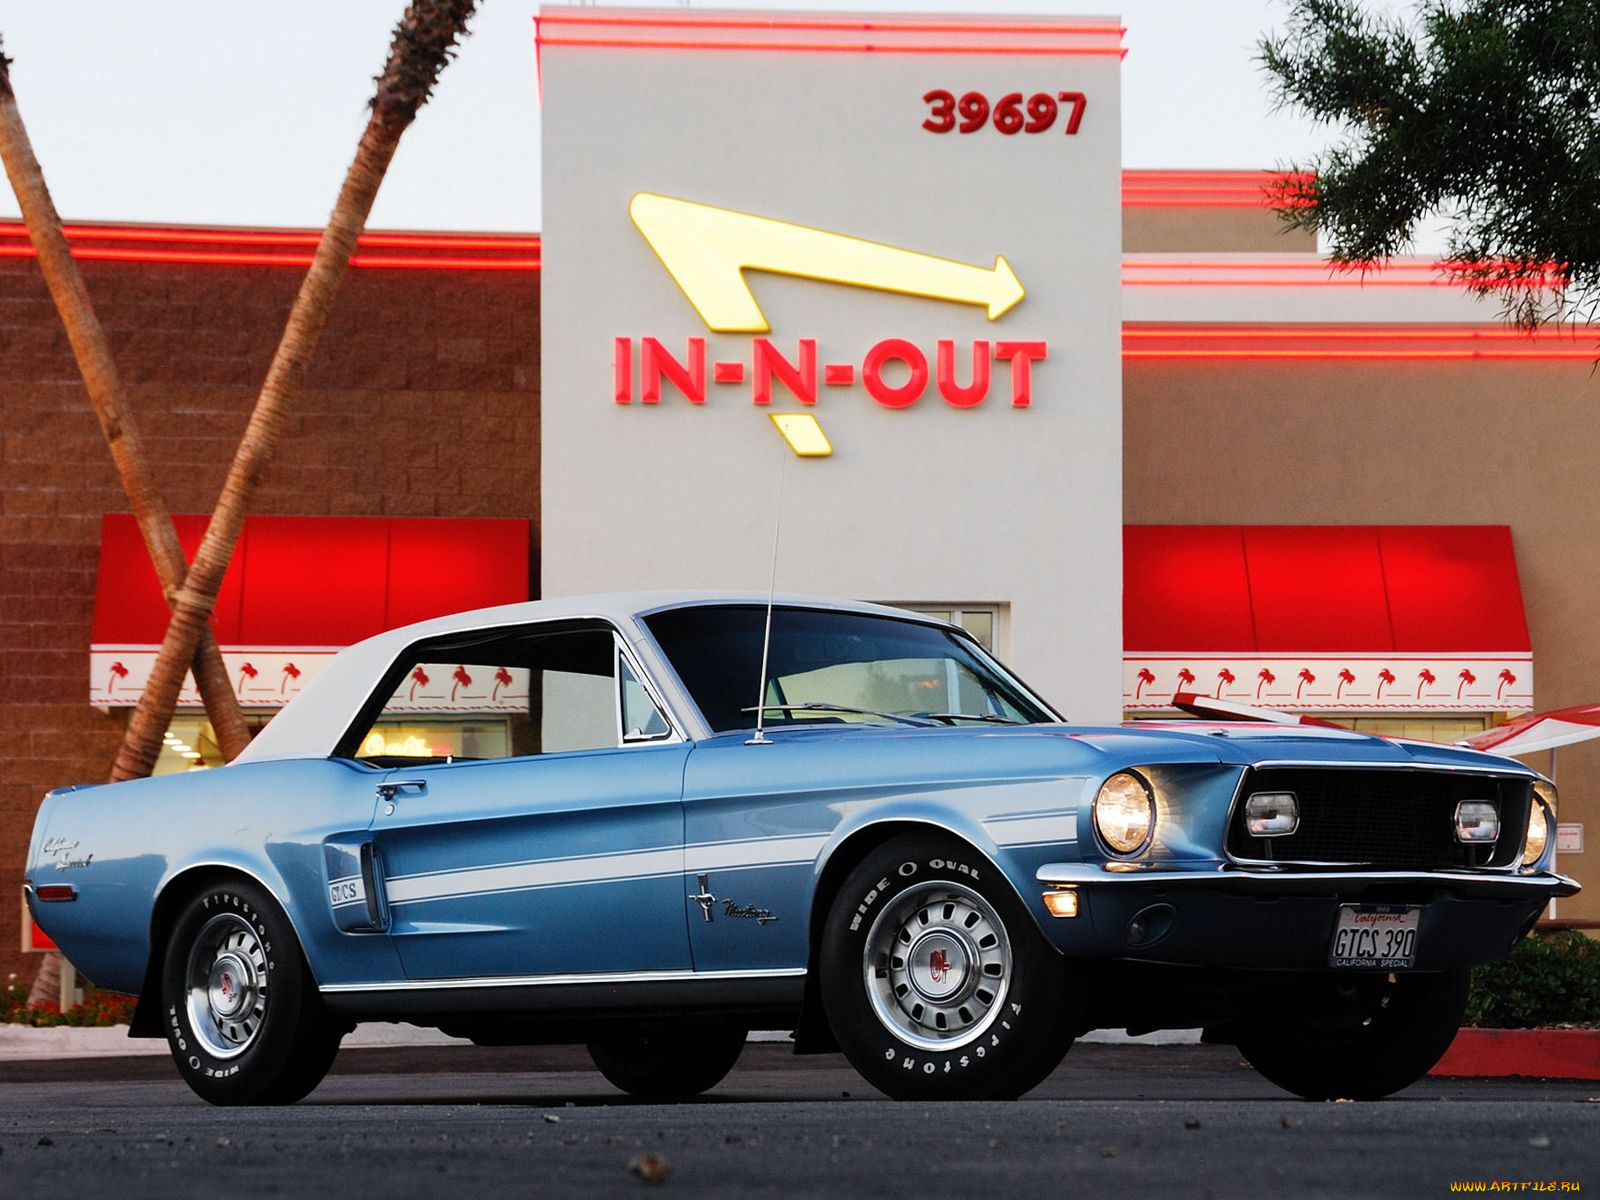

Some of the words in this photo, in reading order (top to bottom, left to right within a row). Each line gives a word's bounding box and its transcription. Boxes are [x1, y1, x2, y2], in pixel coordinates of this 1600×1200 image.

[922, 89, 1087, 135] 39697
[614, 336, 1048, 408] IN-N-OUT
[849, 877, 890, 932] WIDE
[929, 858, 981, 881] OVAL
[202, 894, 276, 971] Firestone
[1335, 928, 1379, 957] GTCS
[1381, 928, 1416, 957] 390
[1336, 958, 1377, 967] CALIFORNIA
[1380, 959, 1409, 968] SPECIAL
[168, 1004, 187, 1052] OVAL
[885, 1002, 1022, 1074] Firestone
[205, 1064, 240, 1079] WIDE
